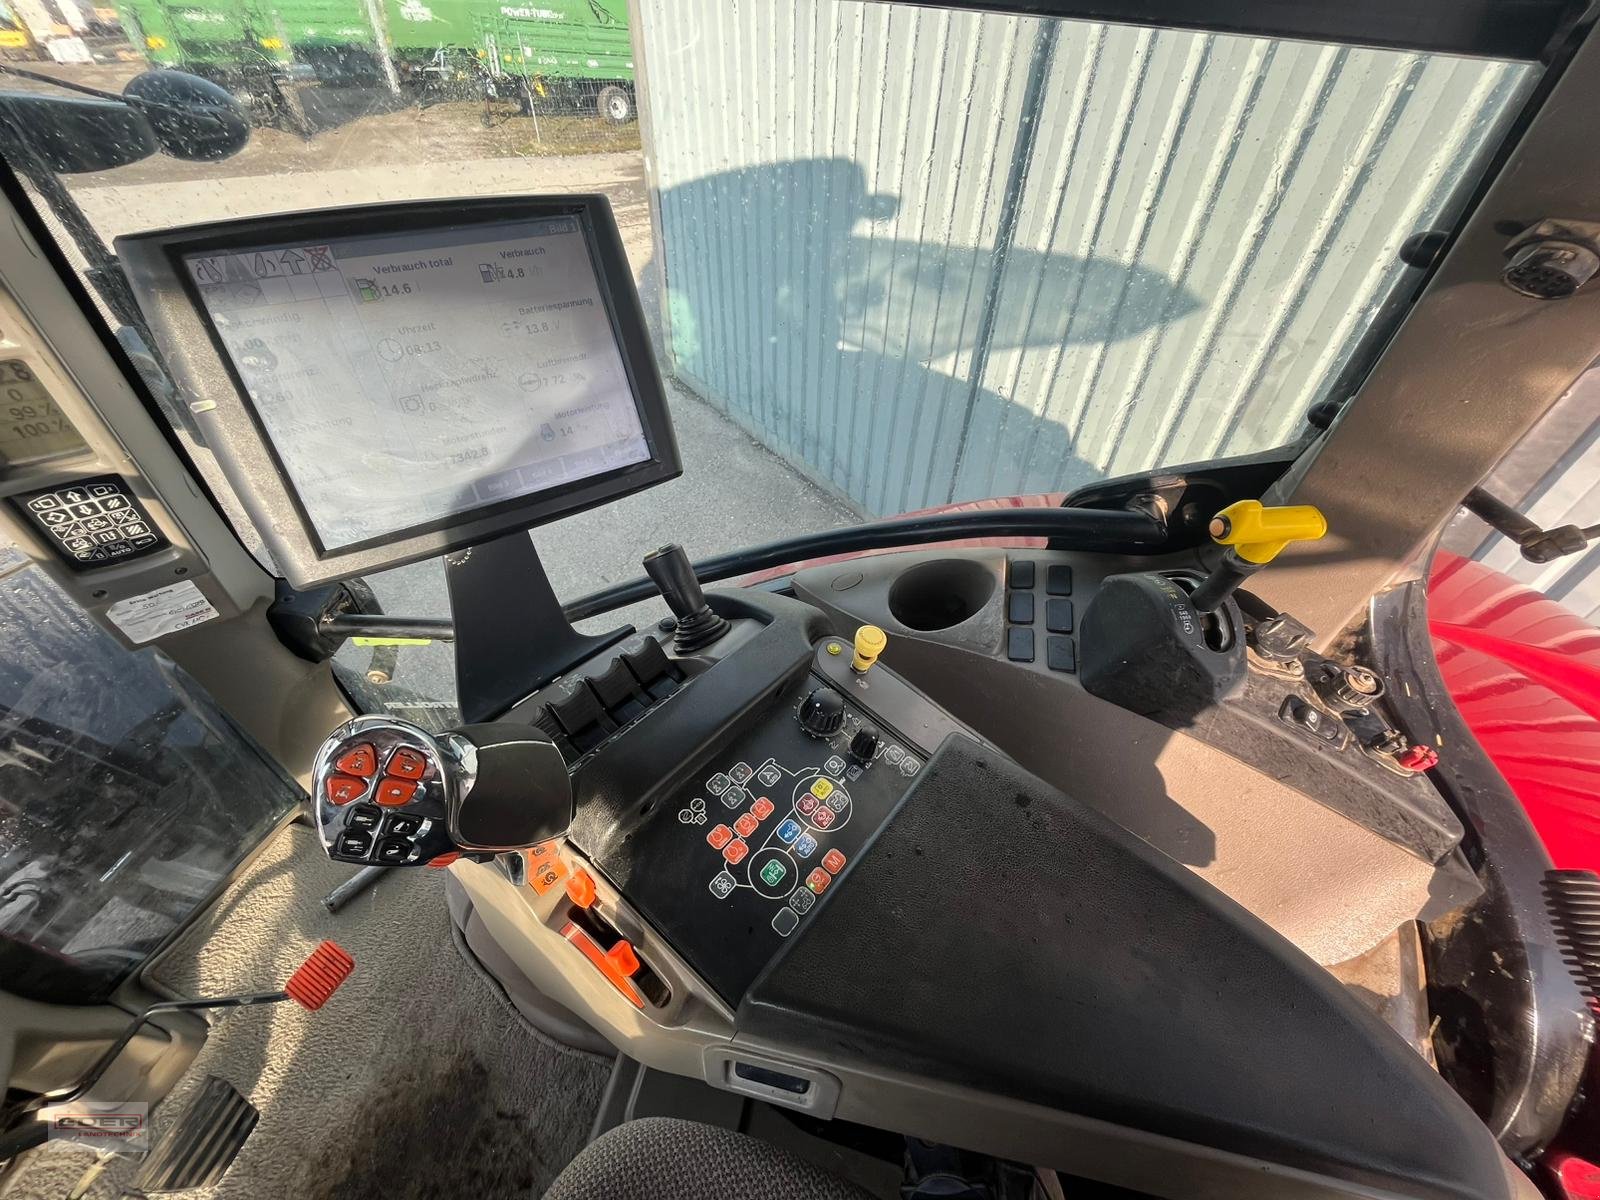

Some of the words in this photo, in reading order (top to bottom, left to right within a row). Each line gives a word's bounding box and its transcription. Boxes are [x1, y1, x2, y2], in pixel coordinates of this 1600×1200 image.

[499, 246, 546, 260] Verbrauch
[372, 260, 428, 276] Verbrauch
[428, 257, 453, 269] total
[381, 282, 412, 298] 14.6
[518, 296, 594, 317] Batteriespannung
[397, 322, 437, 337] Uhrzeit
[405, 341, 442, 357] 08:13
[9, 405, 37, 420] 99
[13, 421, 50, 439] 100
[826, 854, 841, 868] M
